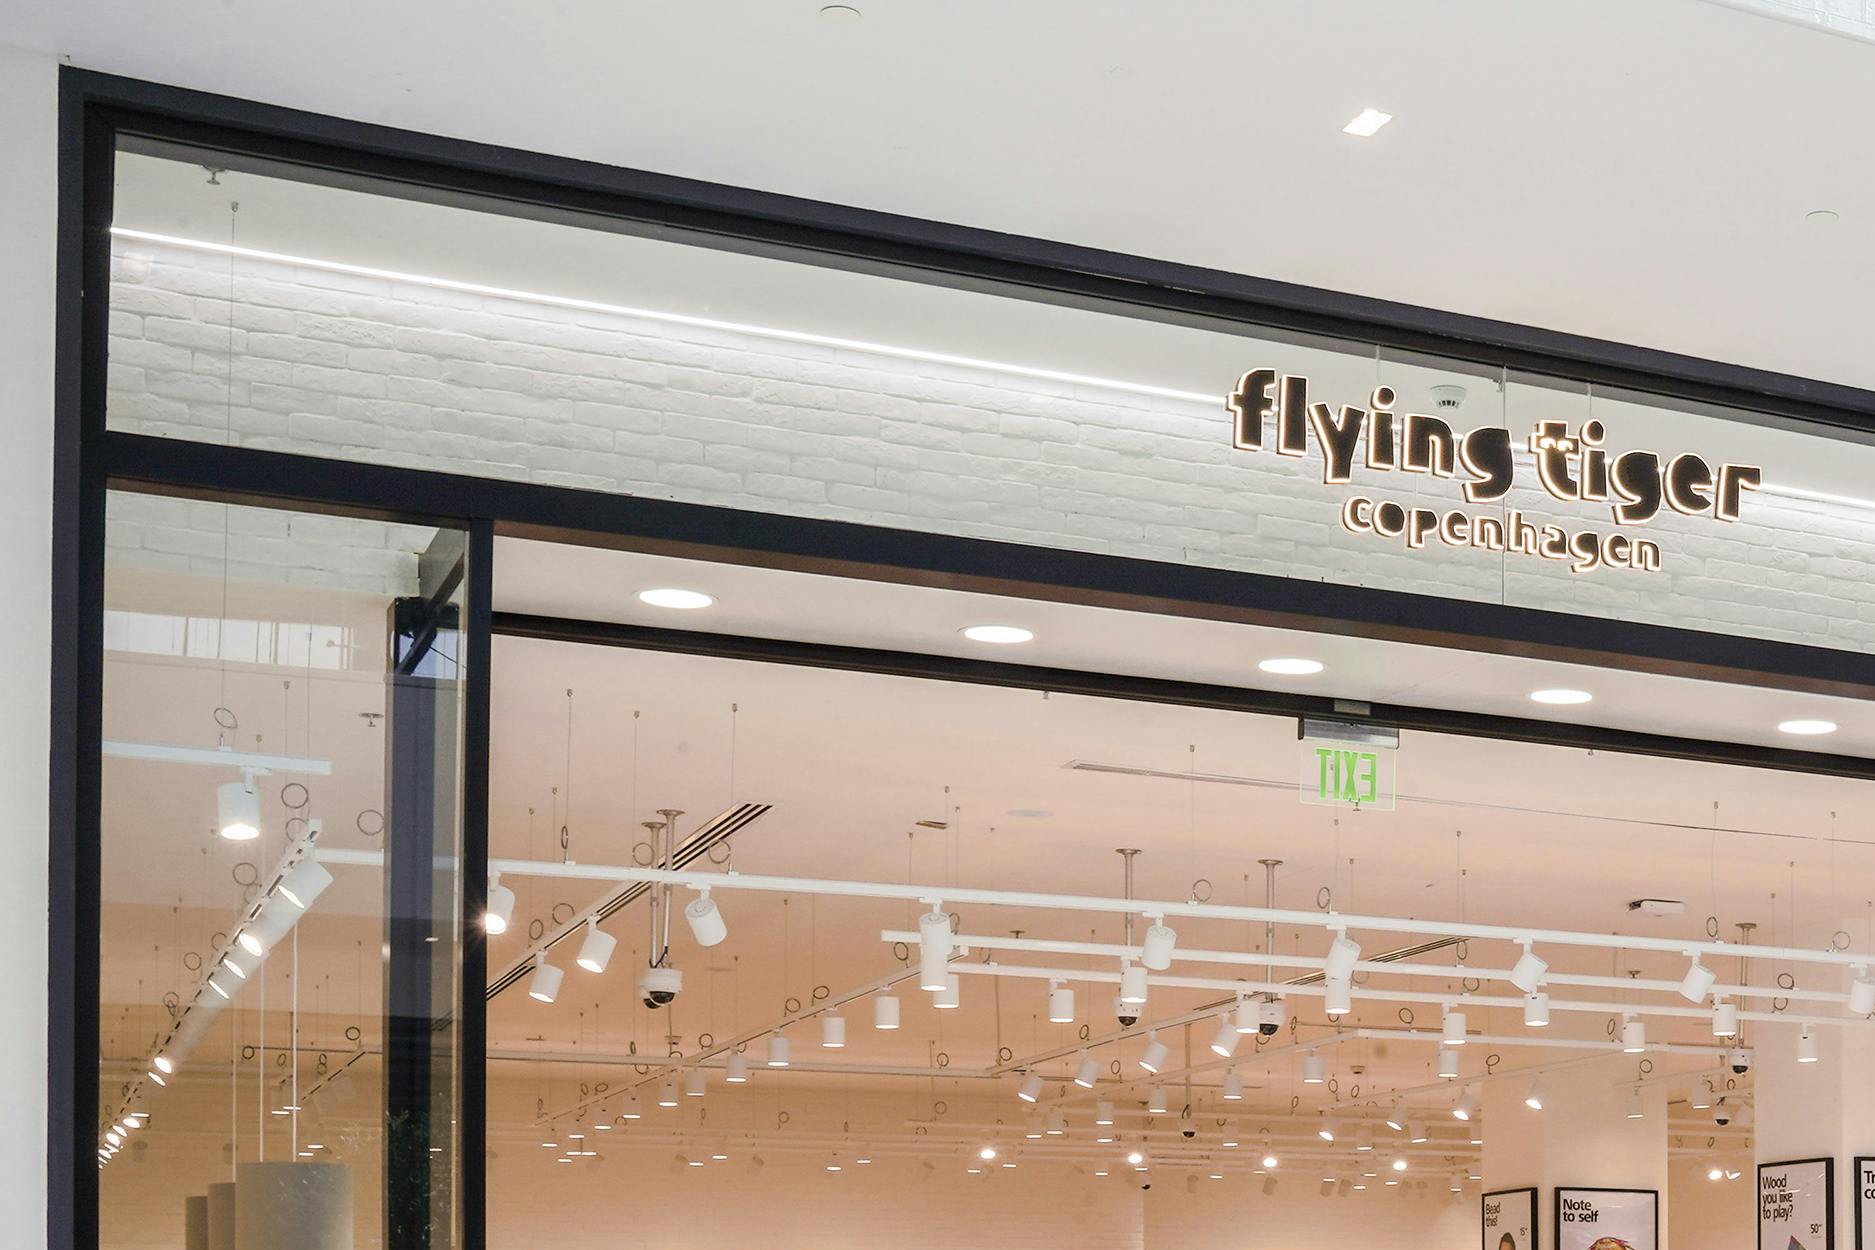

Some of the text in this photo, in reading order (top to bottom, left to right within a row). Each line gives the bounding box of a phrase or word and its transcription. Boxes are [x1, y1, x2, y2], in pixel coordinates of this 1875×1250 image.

[1227, 367, 1762, 526] flying tiger
[1341, 495, 1663, 574] copenhagen
[1762, 1173, 1788, 1190] Wood
[1562, 1198, 1592, 1211] Note
[1762, 1190, 1793, 1208] you like
[1562, 1210, 1599, 1223] to self
[1762, 1204, 1794, 1222] to play?
